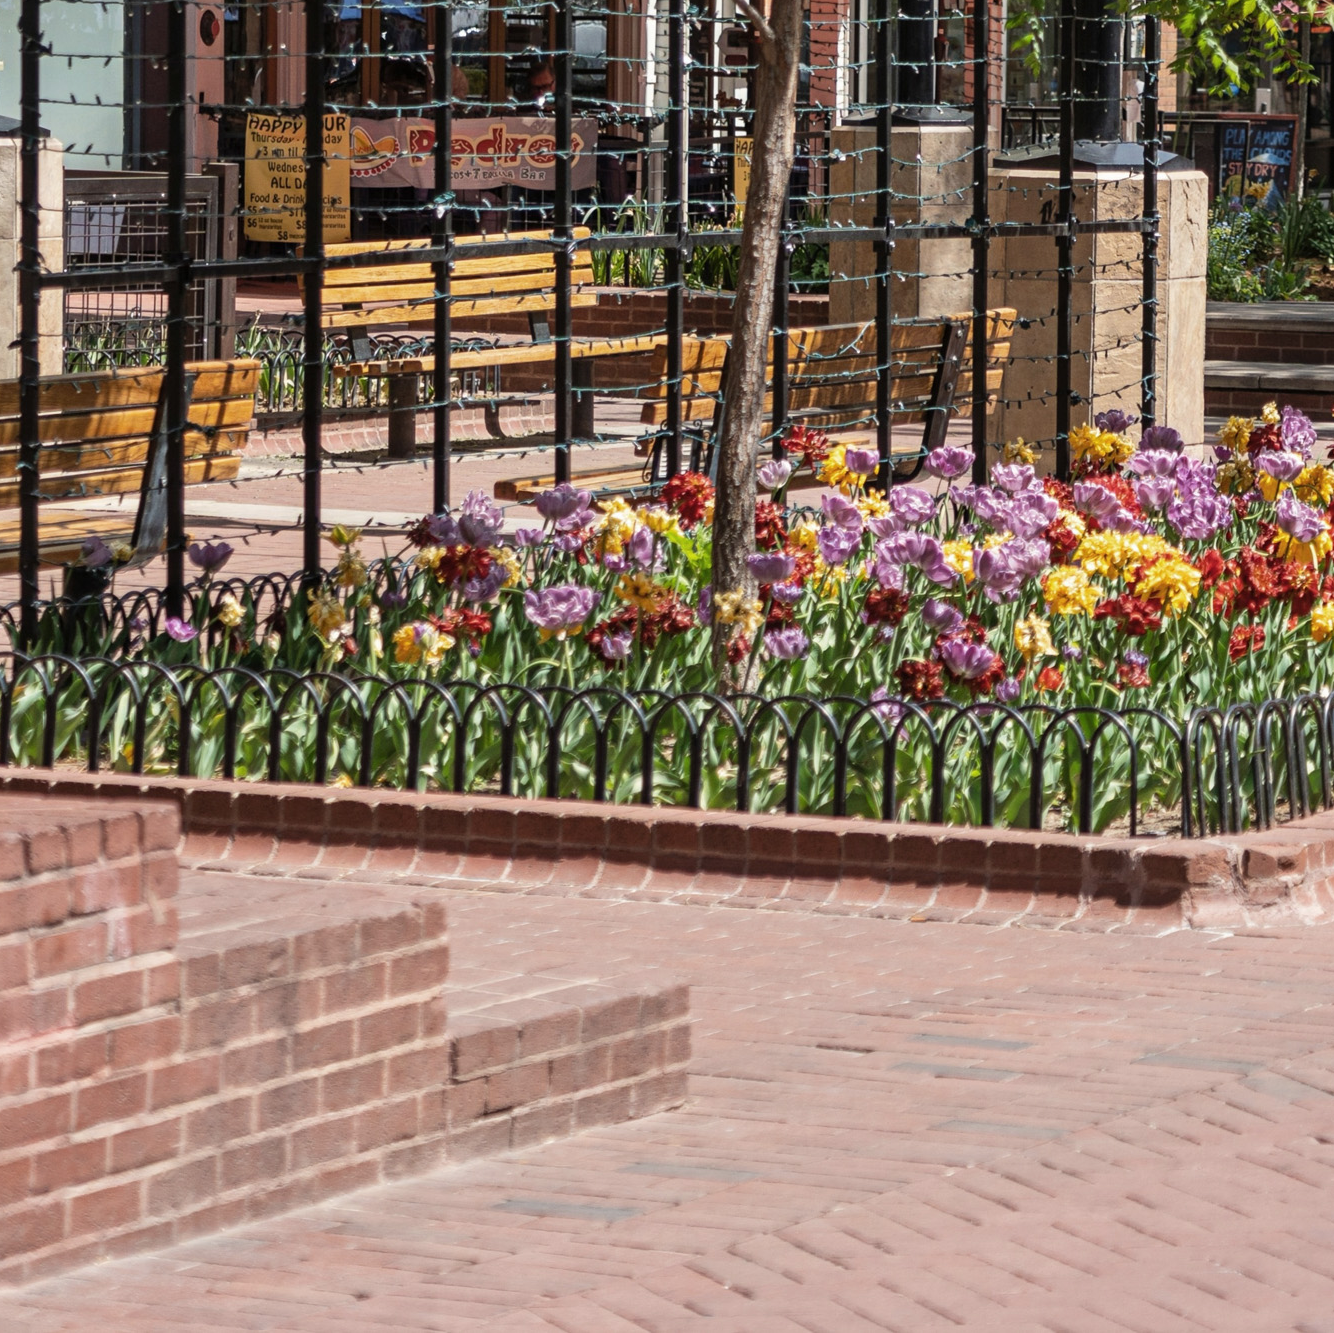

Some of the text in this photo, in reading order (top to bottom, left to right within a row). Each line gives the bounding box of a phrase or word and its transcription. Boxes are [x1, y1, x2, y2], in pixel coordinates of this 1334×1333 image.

[248, 116, 303, 134] HAPPY
[250, 132, 294, 144] Thursday
[1254, 131, 1290, 146] AMONG
[263, 146, 269, 156] 3
[288, 147, 298, 156] til
[409, 126, 581, 167] Pedro
[1223, 147, 1244, 161] THE
[267, 162, 306, 173] Wednes
[1254, 163, 1278, 178] DRY
[270, 177, 292, 189] ALL
[250, 193, 305, 204] Food & Drink
[247, 218, 258, 228] $6
[277, 231, 289, 241] $8
